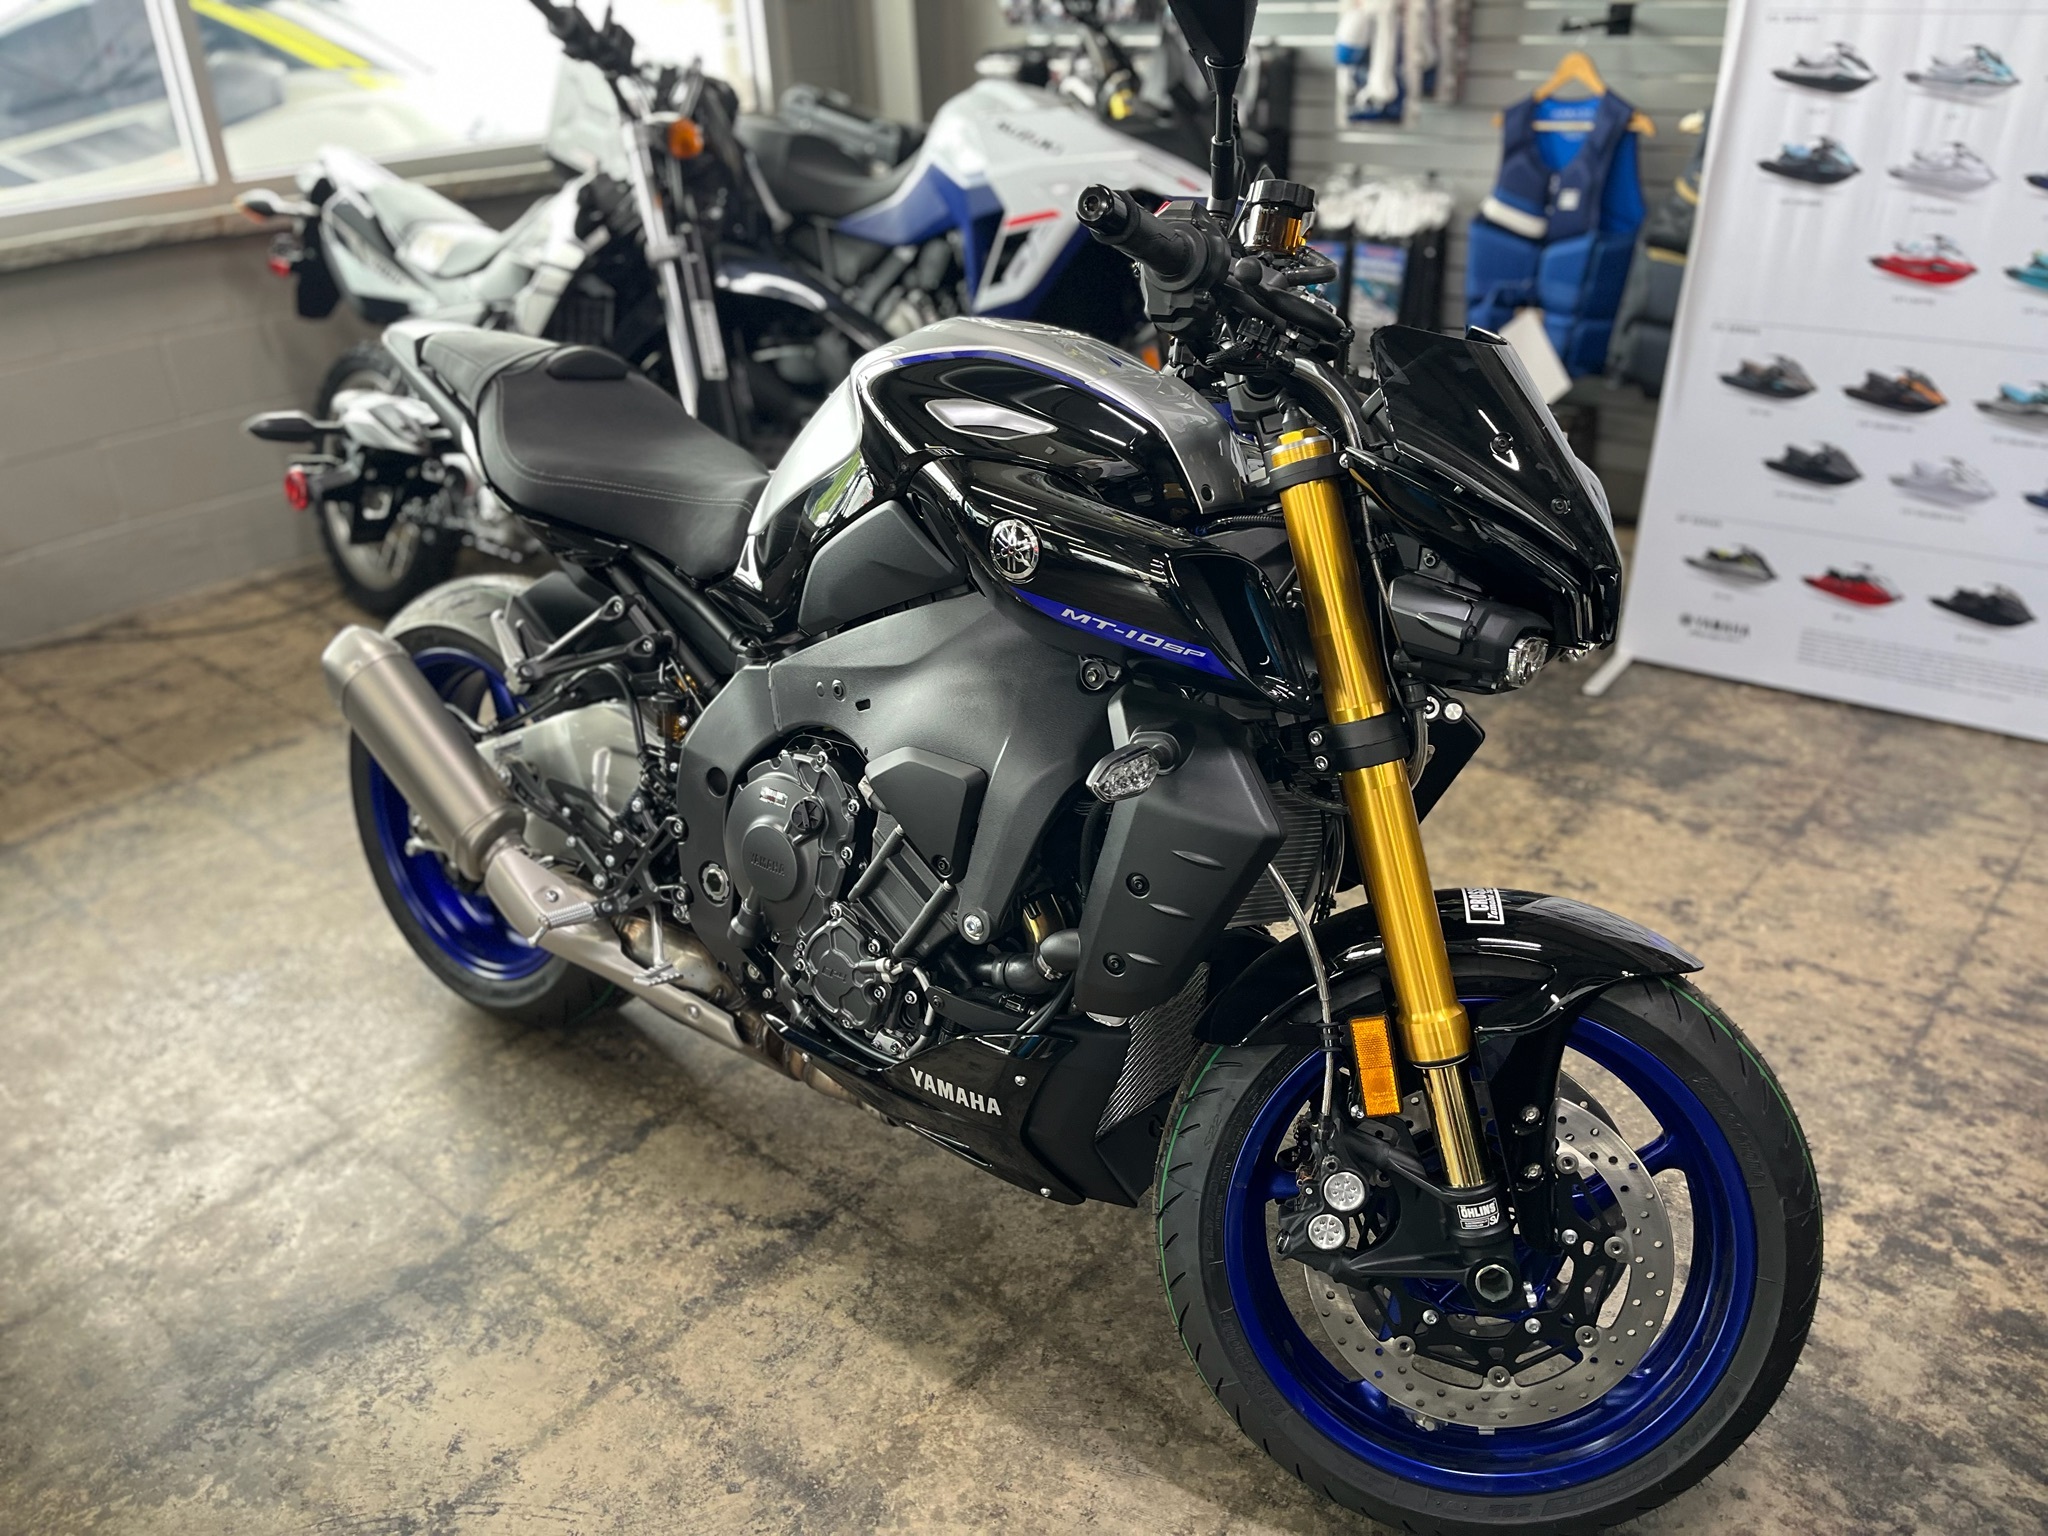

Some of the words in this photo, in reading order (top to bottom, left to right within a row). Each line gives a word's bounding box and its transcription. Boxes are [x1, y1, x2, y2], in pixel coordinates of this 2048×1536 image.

[750, 852, 786, 877] YAMAHA
[909, 1066, 1002, 1116] YAMAHA
[1460, 1202, 1496, 1218] ÖHLINS
